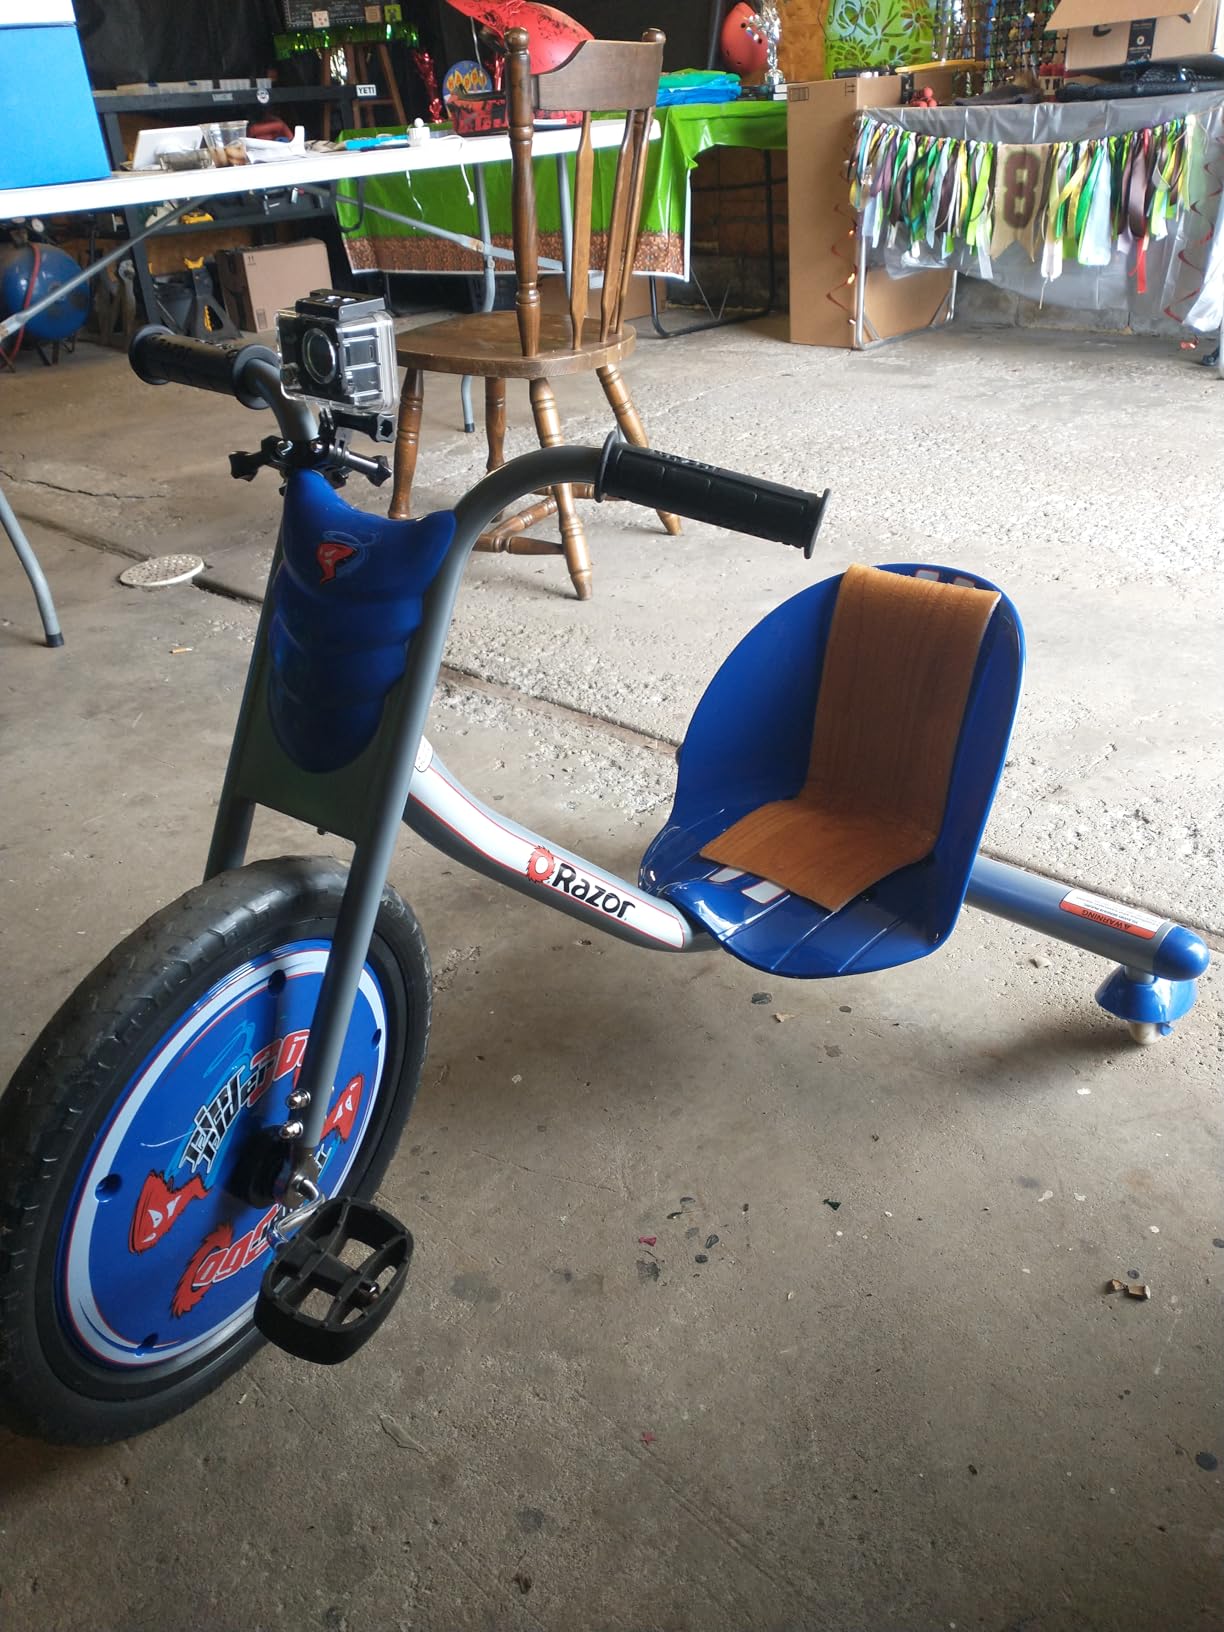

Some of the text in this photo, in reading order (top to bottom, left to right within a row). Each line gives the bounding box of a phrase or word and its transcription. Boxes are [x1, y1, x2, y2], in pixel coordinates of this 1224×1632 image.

[357, 86, 376, 95] YETI
[1003, 151, 1040, 229] 8
[551, 863, 636, 918] Razor
[1082, 909, 1123, 929] WARNING
